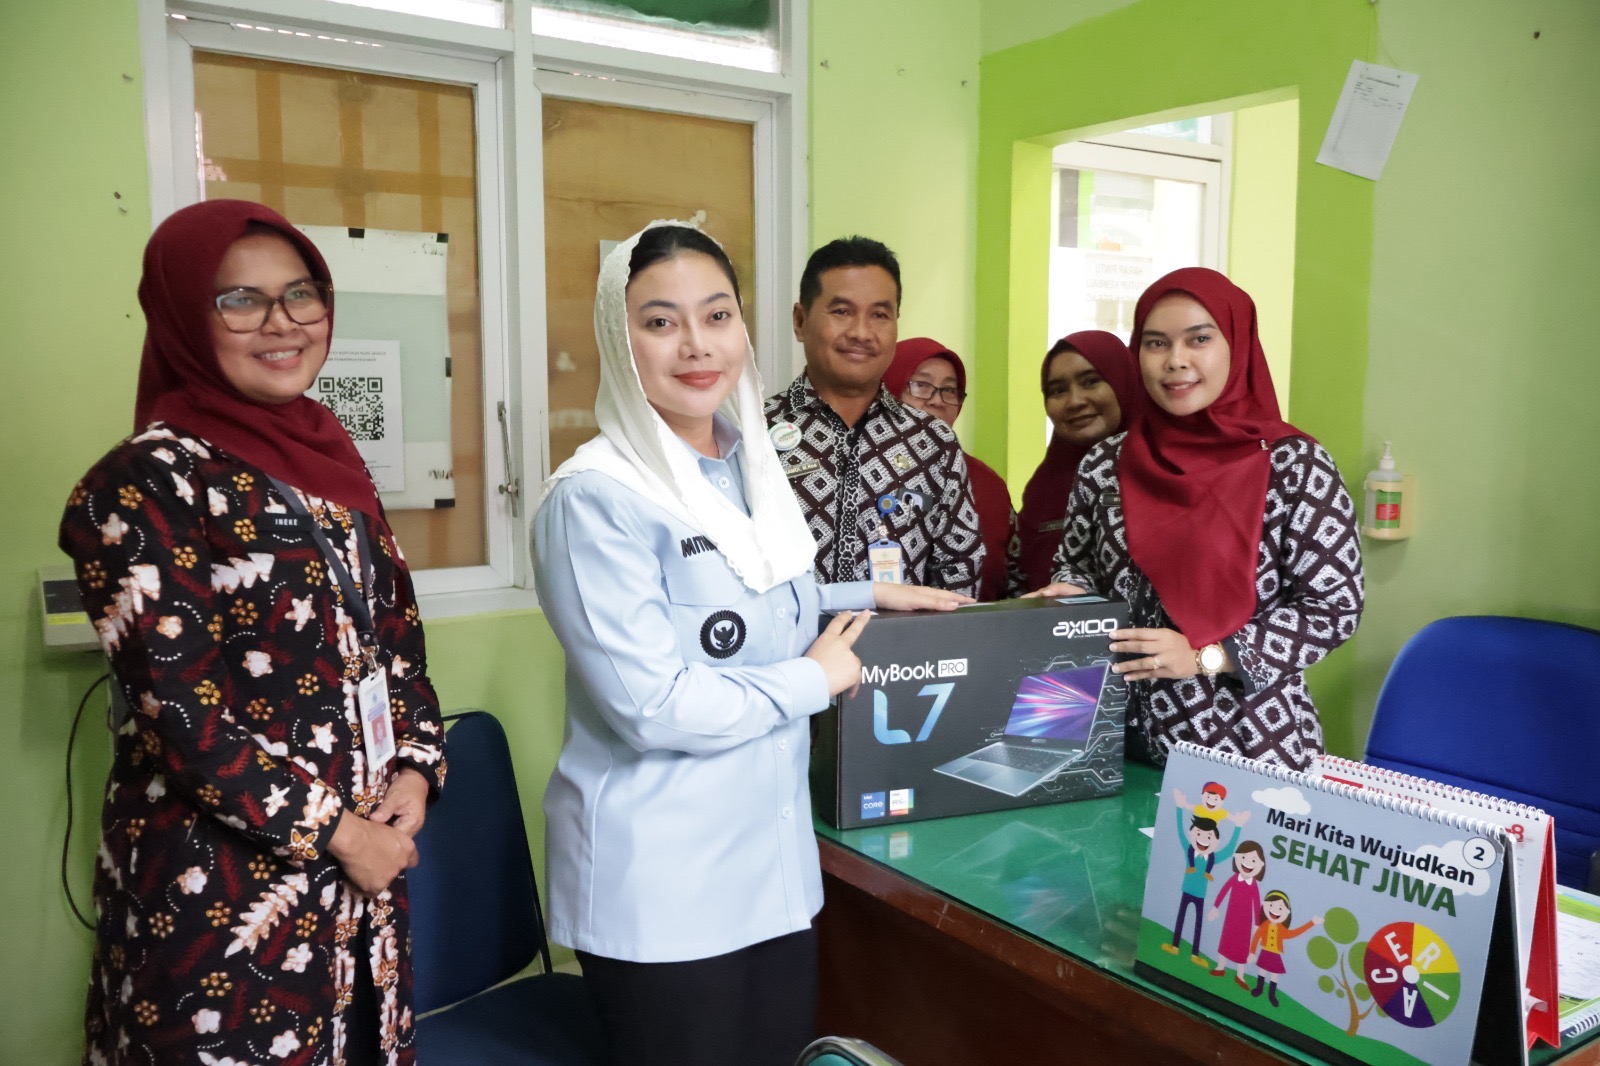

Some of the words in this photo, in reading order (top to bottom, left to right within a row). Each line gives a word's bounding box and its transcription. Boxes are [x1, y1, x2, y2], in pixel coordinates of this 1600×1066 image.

[349, 404, 364, 412] s.id
[275, 518, 298, 526] INEKE
[861, 661, 935, 687] MyBook
[940, 661, 965, 675] PRO
[873, 682, 956, 745] L7
[1266, 807, 1311, 836] Mari
[1314, 821, 1355, 849] Kita
[1360, 834, 1475, 886] Wujudkan
[1472, 846, 1485, 862] 2
[1269, 834, 1370, 886] SEHAT
[1372, 867, 1457, 918] JIWA
